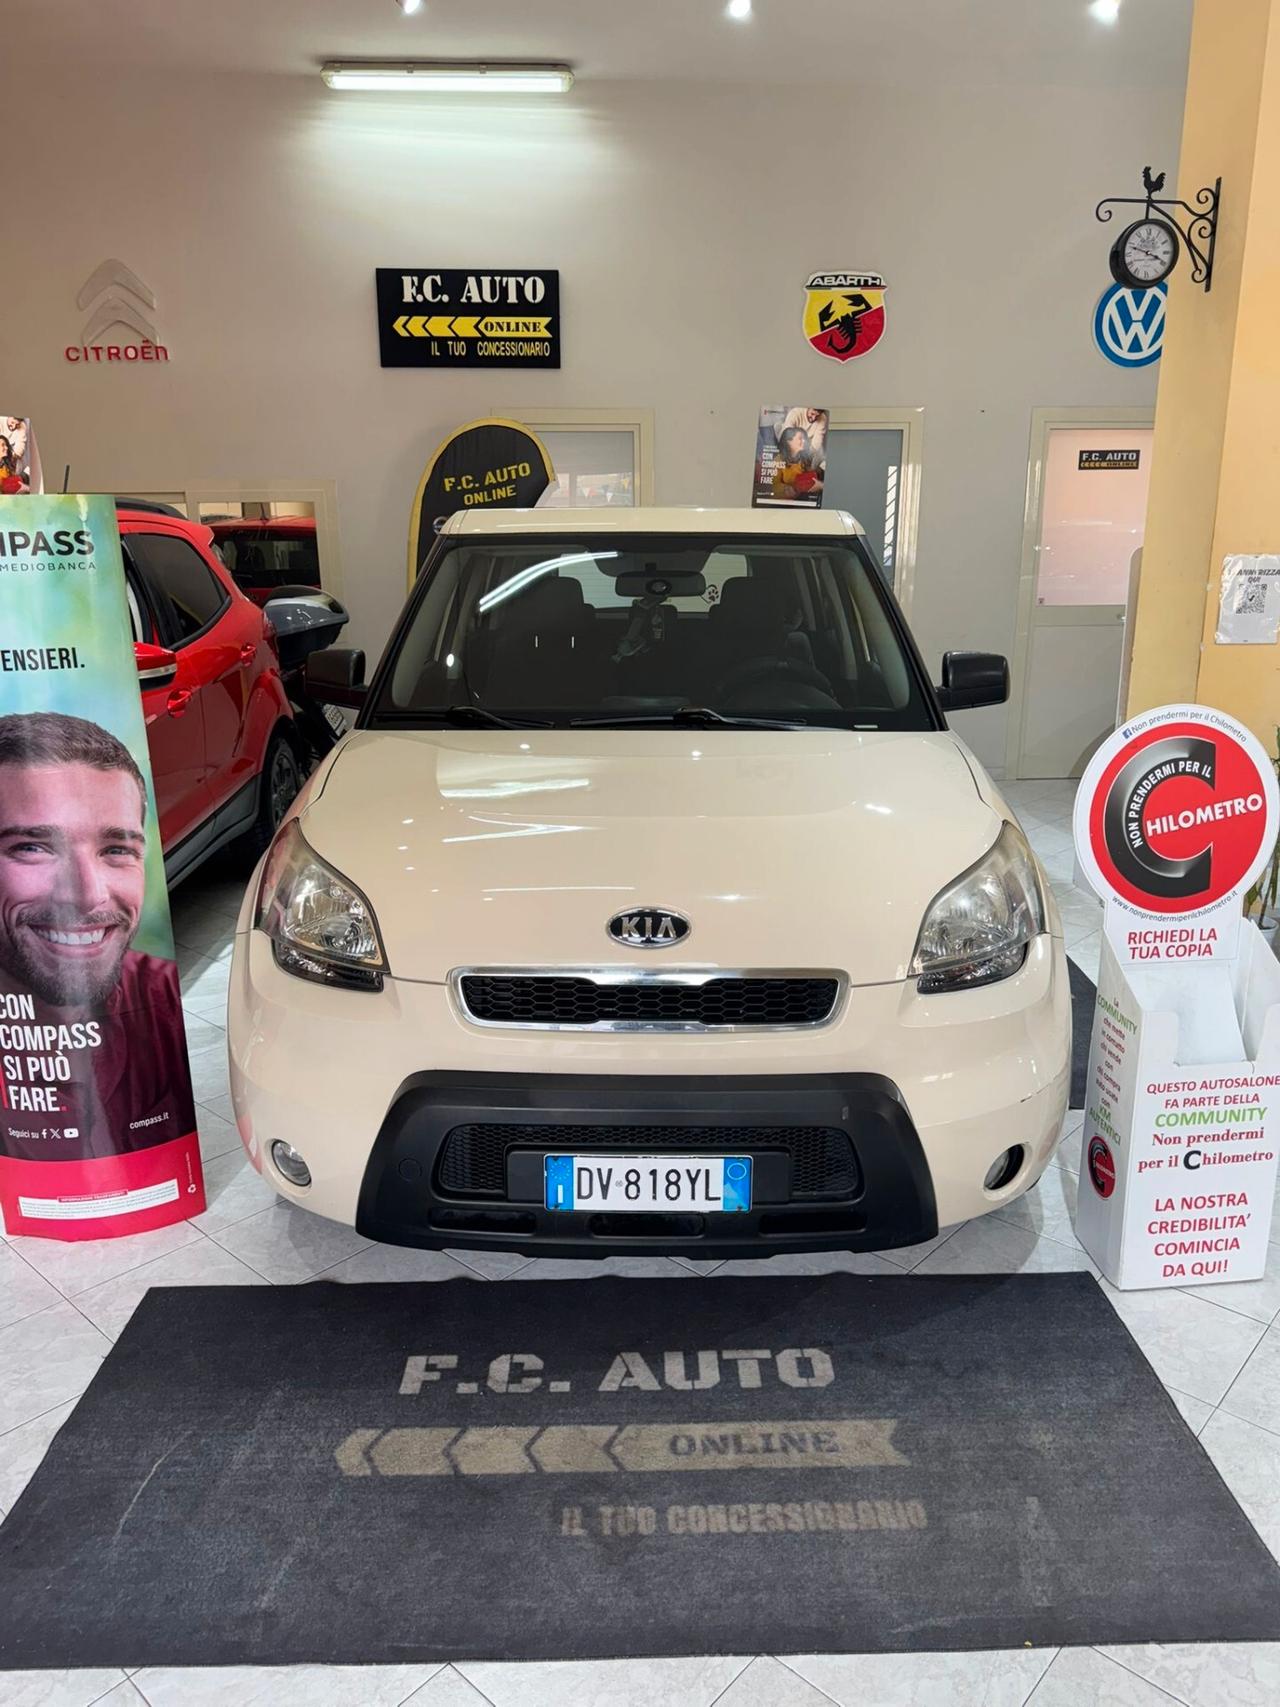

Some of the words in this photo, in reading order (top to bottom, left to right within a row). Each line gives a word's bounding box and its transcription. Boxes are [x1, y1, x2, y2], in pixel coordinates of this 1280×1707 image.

[401, 275, 449, 303] F.C.
[460, 276, 545, 303] AUTO
[812, 276, 880, 286] ABARTH
[484, 321, 542, 333] ONLINE
[431, 341, 440, 356] IL
[448, 341, 466, 356] TUO
[477, 341, 550, 356] CONCESSIONARIO
[1106, 452, 1136, 461] AUTO
[444, 475, 480, 492] F.C.
[484, 462, 531, 486] AUTO
[464, 485, 516, 505] ONLINE
[0, 531, 95, 557] PASS
[0, 561, 96, 571] MEDIOBANCA
[1132, 721, 1147, 734] Non
[1149, 711, 1188, 725] prendermi
[1190, 711, 1202, 720] per
[1210, 715, 1247, 742] Chilometro
[1179, 761, 1200, 774] PER
[1202, 765, 1212, 778] IL
[1129, 762, 1176, 818] PRENDERMI
[1146, 793, 1263, 837] HILOMETRO
[1129, 824, 1143, 849] NON
[621, 916, 676, 938] KIA
[1128, 929, 1194, 945] RICHIEDI
[1199, 928, 1217, 941] LA
[1130, 946, 1160, 959] TUA
[1165, 943, 1212, 958] COPIA
[1097, 994, 1137, 1035] COMMUNITY
[0, 1021, 101, 1051] COMPASS
[3, 1055, 23, 1081] SI
[27, 1051, 70, 1081] PUÒ
[1147, 1080, 1197, 1095] QUESTO
[1200, 1075, 1280, 1090] AUTOSALONE
[1165, 1099, 1179, 1109] FA
[1183, 1096, 1220, 1108] PARTE
[1223, 1093, 1260, 1105] DELLA
[129, 1112, 169, 1130] compass.it
[1155, 1107, 1267, 1127] COMMUNITY
[8, 1127, 30, 1138] Seguici
[31, 1131, 39, 1139] su
[1152, 1133, 1182, 1146] Non
[1186, 1127, 1264, 1148] prendermi
[1138, 1159, 1164, 1173] per
[1168, 1155, 1179, 1168] il
[1155, 1198, 1175, 1212] LA
[1181, 1192, 1248, 1211] NOSTRA
[1154, 1237, 1240, 1256] COMINCIA
[1163, 1264, 1185, 1277] DA
[1191, 1259, 1228, 1276] QUI!
[400, 1354, 571, 1395] F.C.
[598, 1347, 835, 1393] AUTO
[669, 1429, 840, 1459] ONLINE
[561, 1506, 586, 1537] IL
[598, 1504, 657, 1535] TUO
[665, 1500, 927, 1534] CONCESSIONARIO
